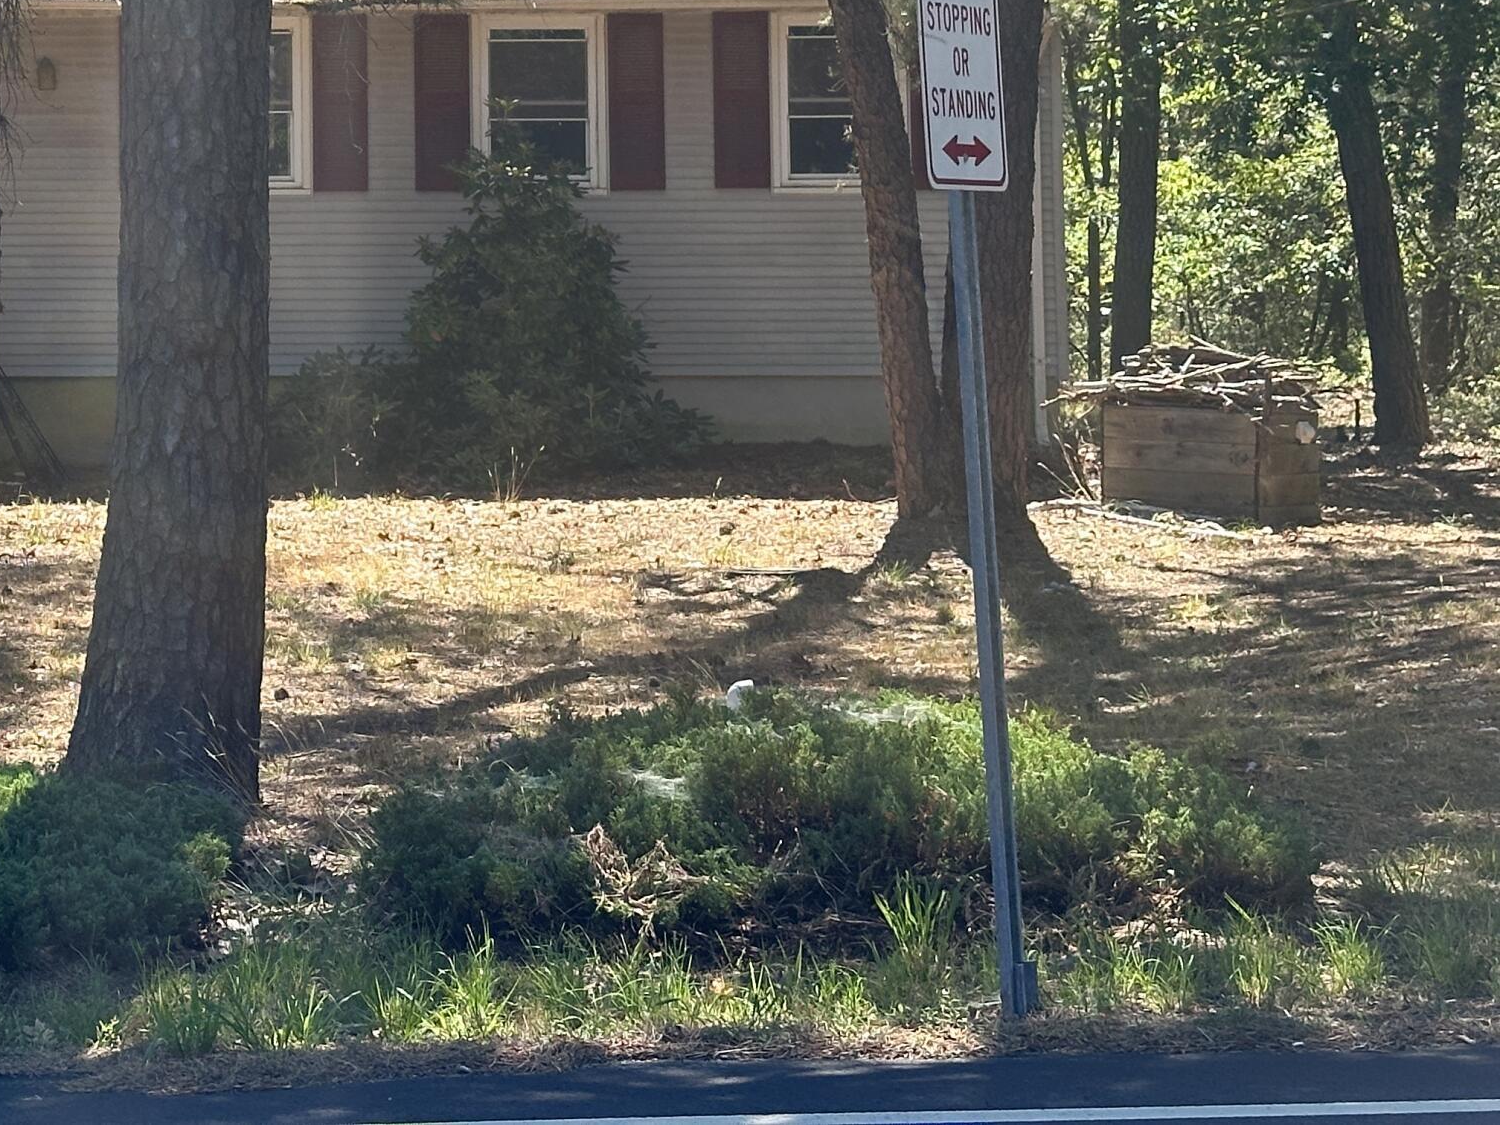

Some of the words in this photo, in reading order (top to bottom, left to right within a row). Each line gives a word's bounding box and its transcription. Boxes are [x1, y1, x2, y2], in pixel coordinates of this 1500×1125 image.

[927, 1, 991, 36] STOPPING
[953, 47, 970, 77] OR
[932, 87, 996, 120] STANDING
